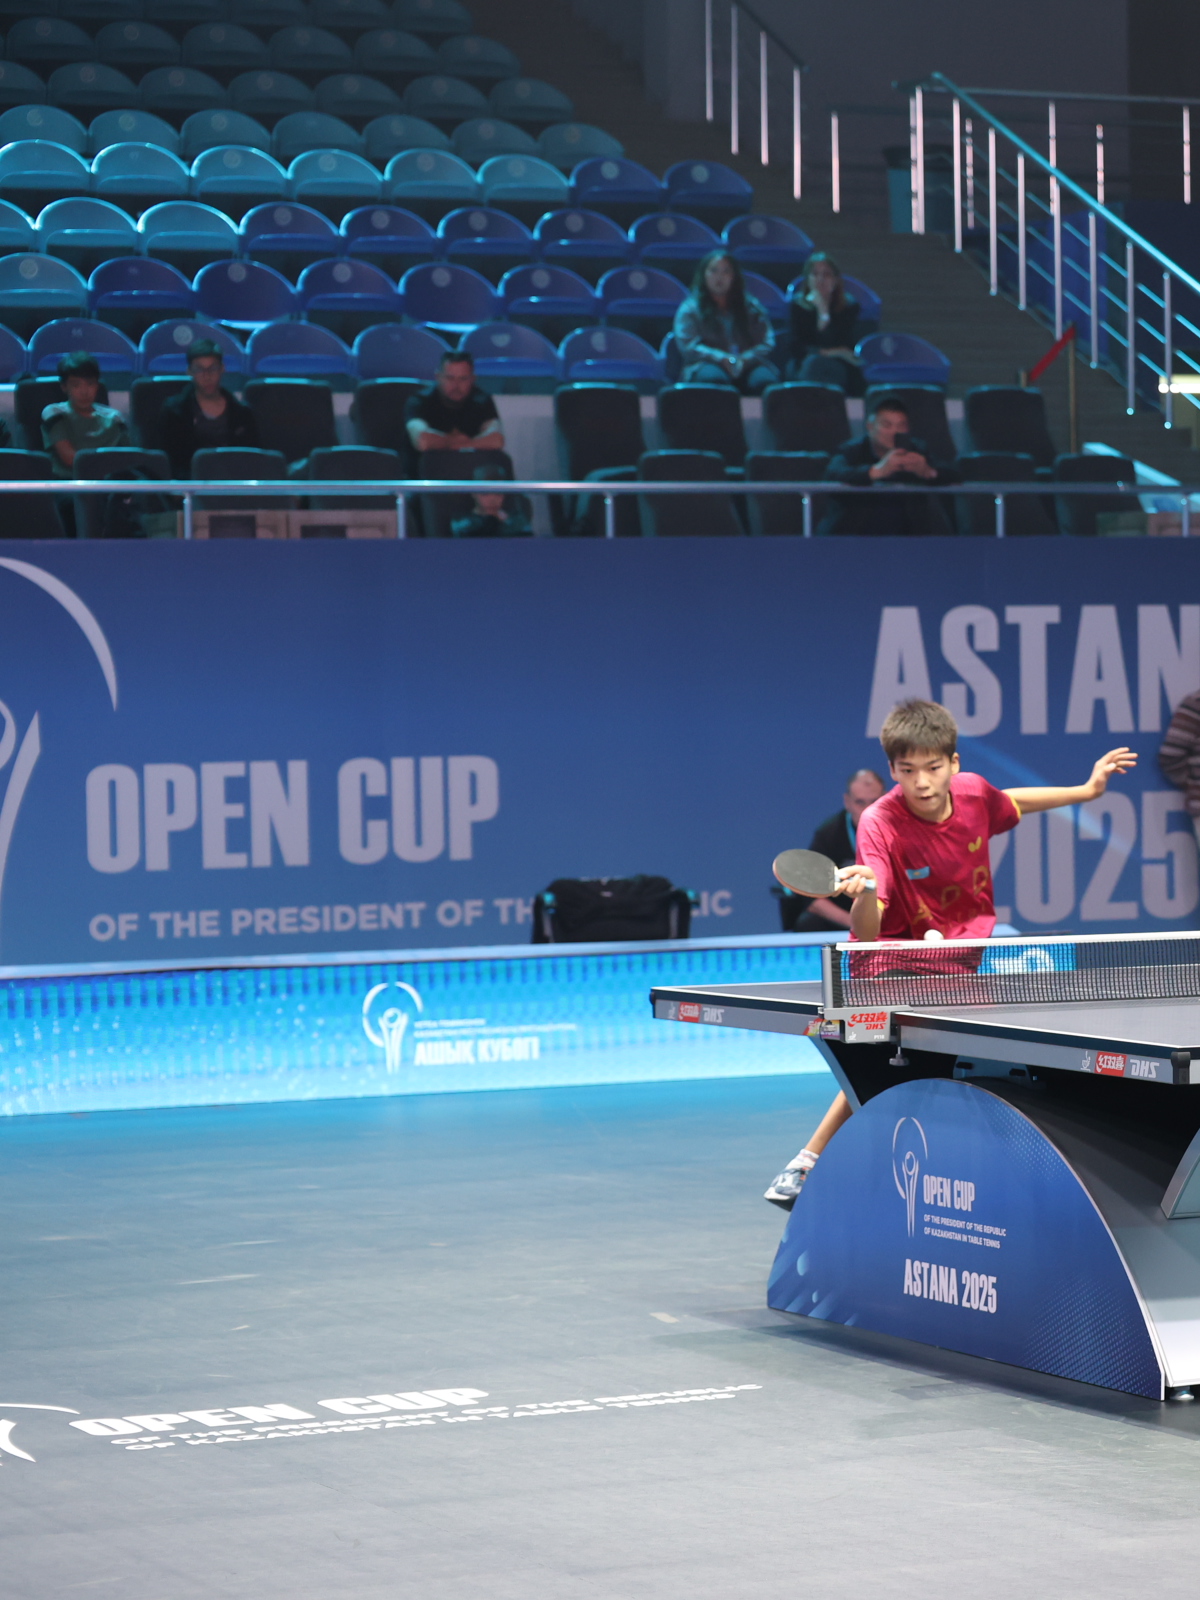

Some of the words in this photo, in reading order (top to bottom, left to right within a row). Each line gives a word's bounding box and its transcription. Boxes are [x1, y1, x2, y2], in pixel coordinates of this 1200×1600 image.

[86, 760, 310, 874] OPEN
[337, 755, 499, 865] CUP
[89, 913, 138, 942] OF
[150, 910, 221, 938] THE
[231, 901, 426, 936] PRESIDENT
[436, 900, 483, 927] OF
[493, 895, 534, 925] TH
[865, 1022, 887, 1030] DHS
[1130, 1058, 1160, 1079] DHS
[923, 1174, 951, 1208] OPEN
[953, 1179, 975, 1212] CUP
[924, 1214, 931, 1222] OF
[931, 1215, 941, 1225] THE
[940, 1217, 966, 1229] PRESIDENT
[966, 1222, 974, 1230] OF
[974, 1223, 983, 1232] THE
[983, 1225, 1007, 1237] REPUBLIC
[924, 1226, 931, 1235] OF
[931, 1228, 962, 1241] KAZAKHSTAN
[968, 1235, 983, 1246] TABLE
[983, 1237, 1001, 1249] TENNIS
[903, 1258, 959, 1306] ASTANA
[961, 1270, 998, 1313] 2025
[68, 1403, 316, 1436] OPEN
[317, 1387, 489, 1415] CUP
[110, 1436, 161, 1445] OF
[169, 1429, 246, 1439] THE
[252, 1411, 449, 1432] PRESIDENT
[461, 1406, 509, 1415] OF
[515, 1399, 590, 1410] THE
[594, 1384, 763, 1403] REPUBLIC
[125, 1442, 176, 1451] OF
[185, 1419, 437, 1445] KAZAKHSTAN
[442, 1415, 483, 1423] IN
[487, 1405, 604, 1419] TABLE
[606, 1393, 736, 1409] TENNIS
